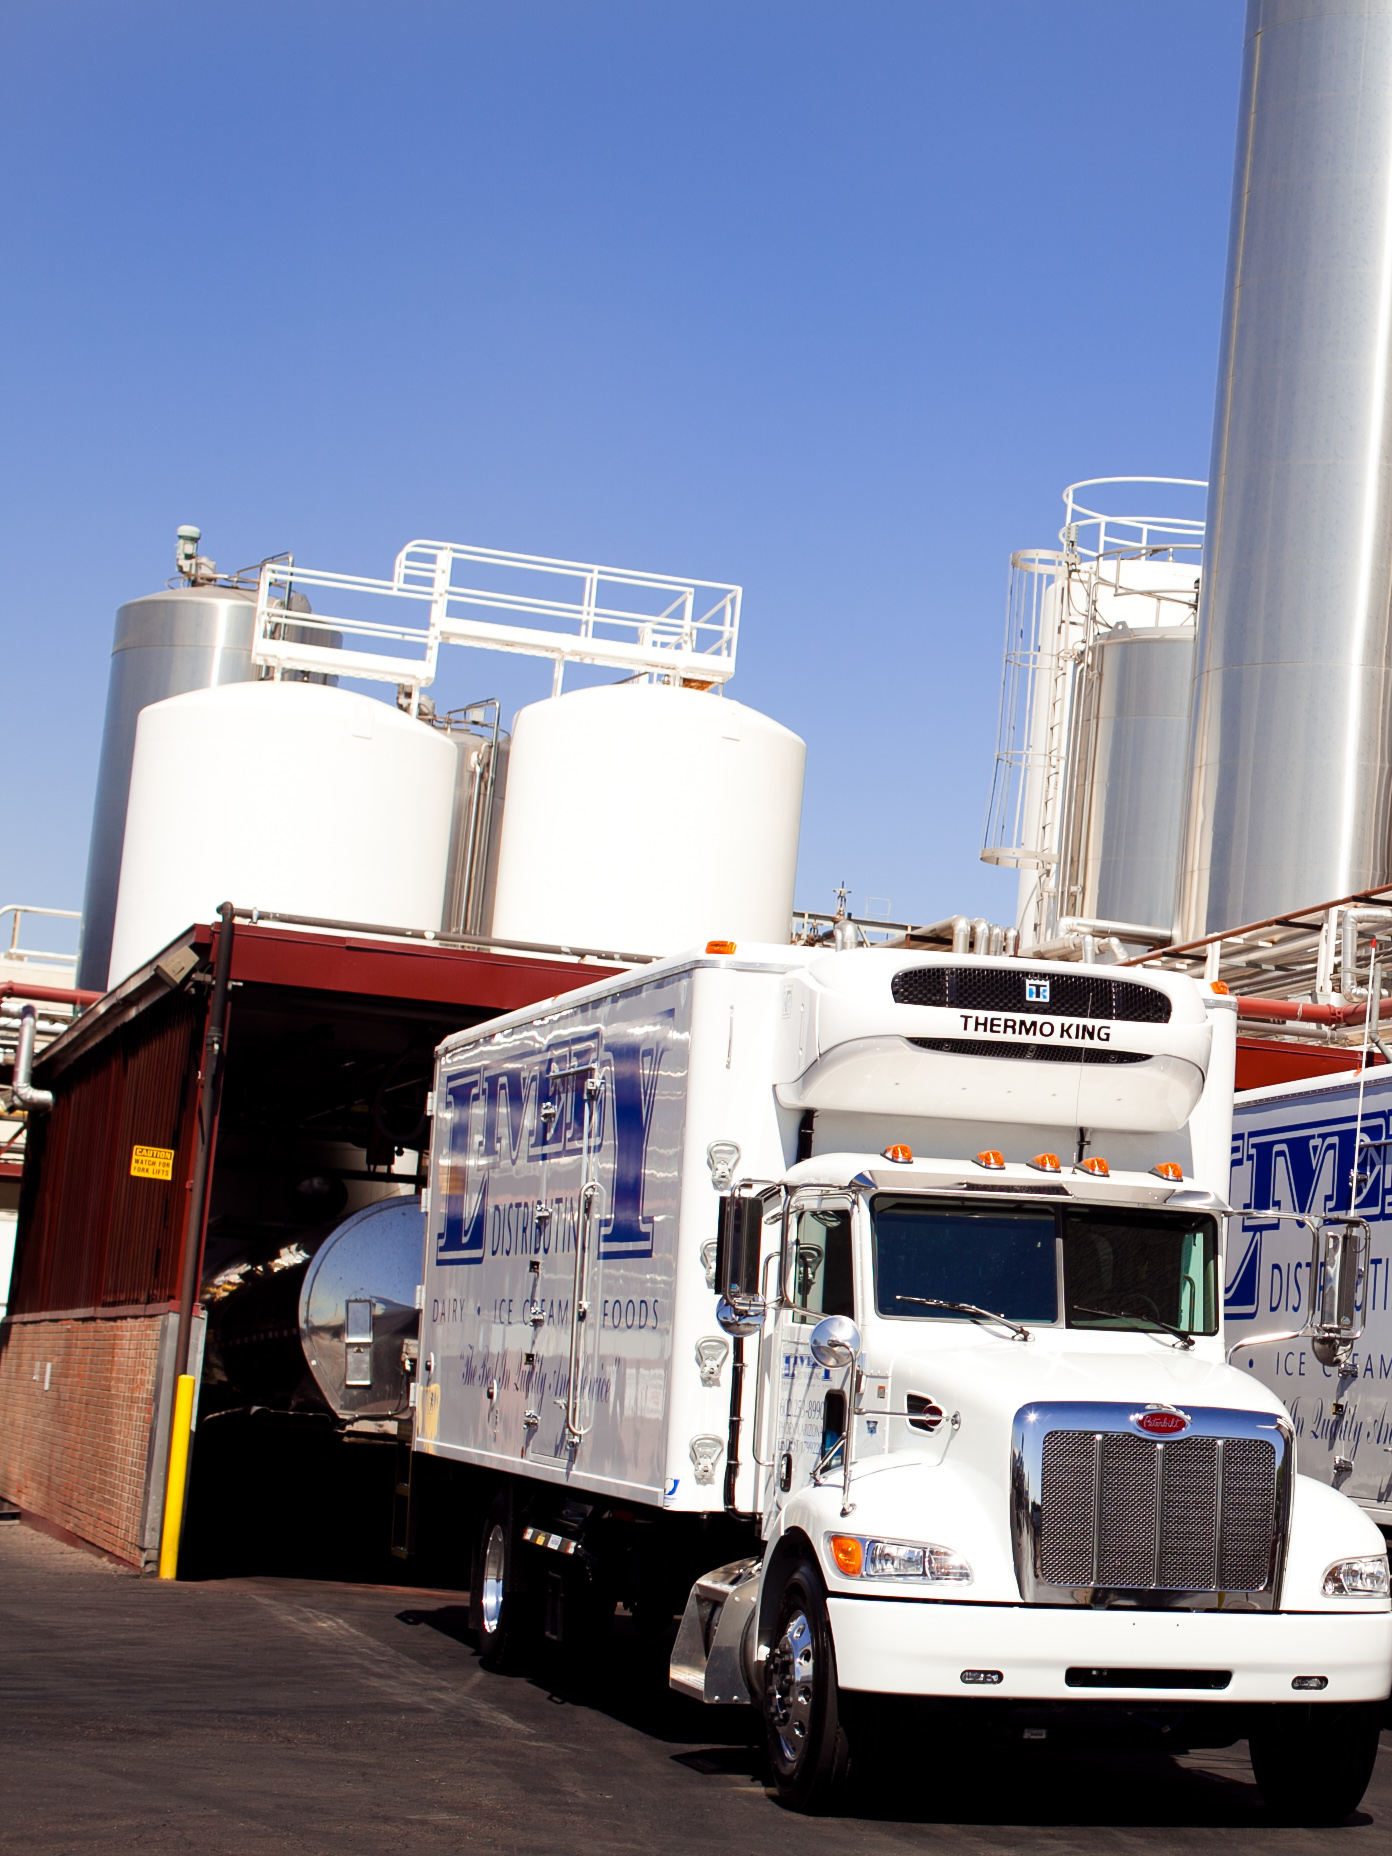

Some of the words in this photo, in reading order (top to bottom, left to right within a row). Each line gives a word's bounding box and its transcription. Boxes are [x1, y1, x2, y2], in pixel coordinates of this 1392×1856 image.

[960, 1014, 1055, 1037] THERMO
[1059, 1022, 1111, 1042] KING
[134, 1158, 156, 1166] WATCH
[136, 1148, 171, 1160] CAUTION
[133, 1166, 149, 1174] FORK
[152, 1168, 169, 1177] LIFTS
[491, 1196, 588, 1257] DISTRIBUTIN
[432, 1298, 465, 1323] DAIRY
[494, 1298, 514, 1325] ICE
[602, 1299, 659, 1330] FOODS
[1276, 1352, 1306, 1376] ICE
[1143, 1415, 1183, 1428] Peterbilt
